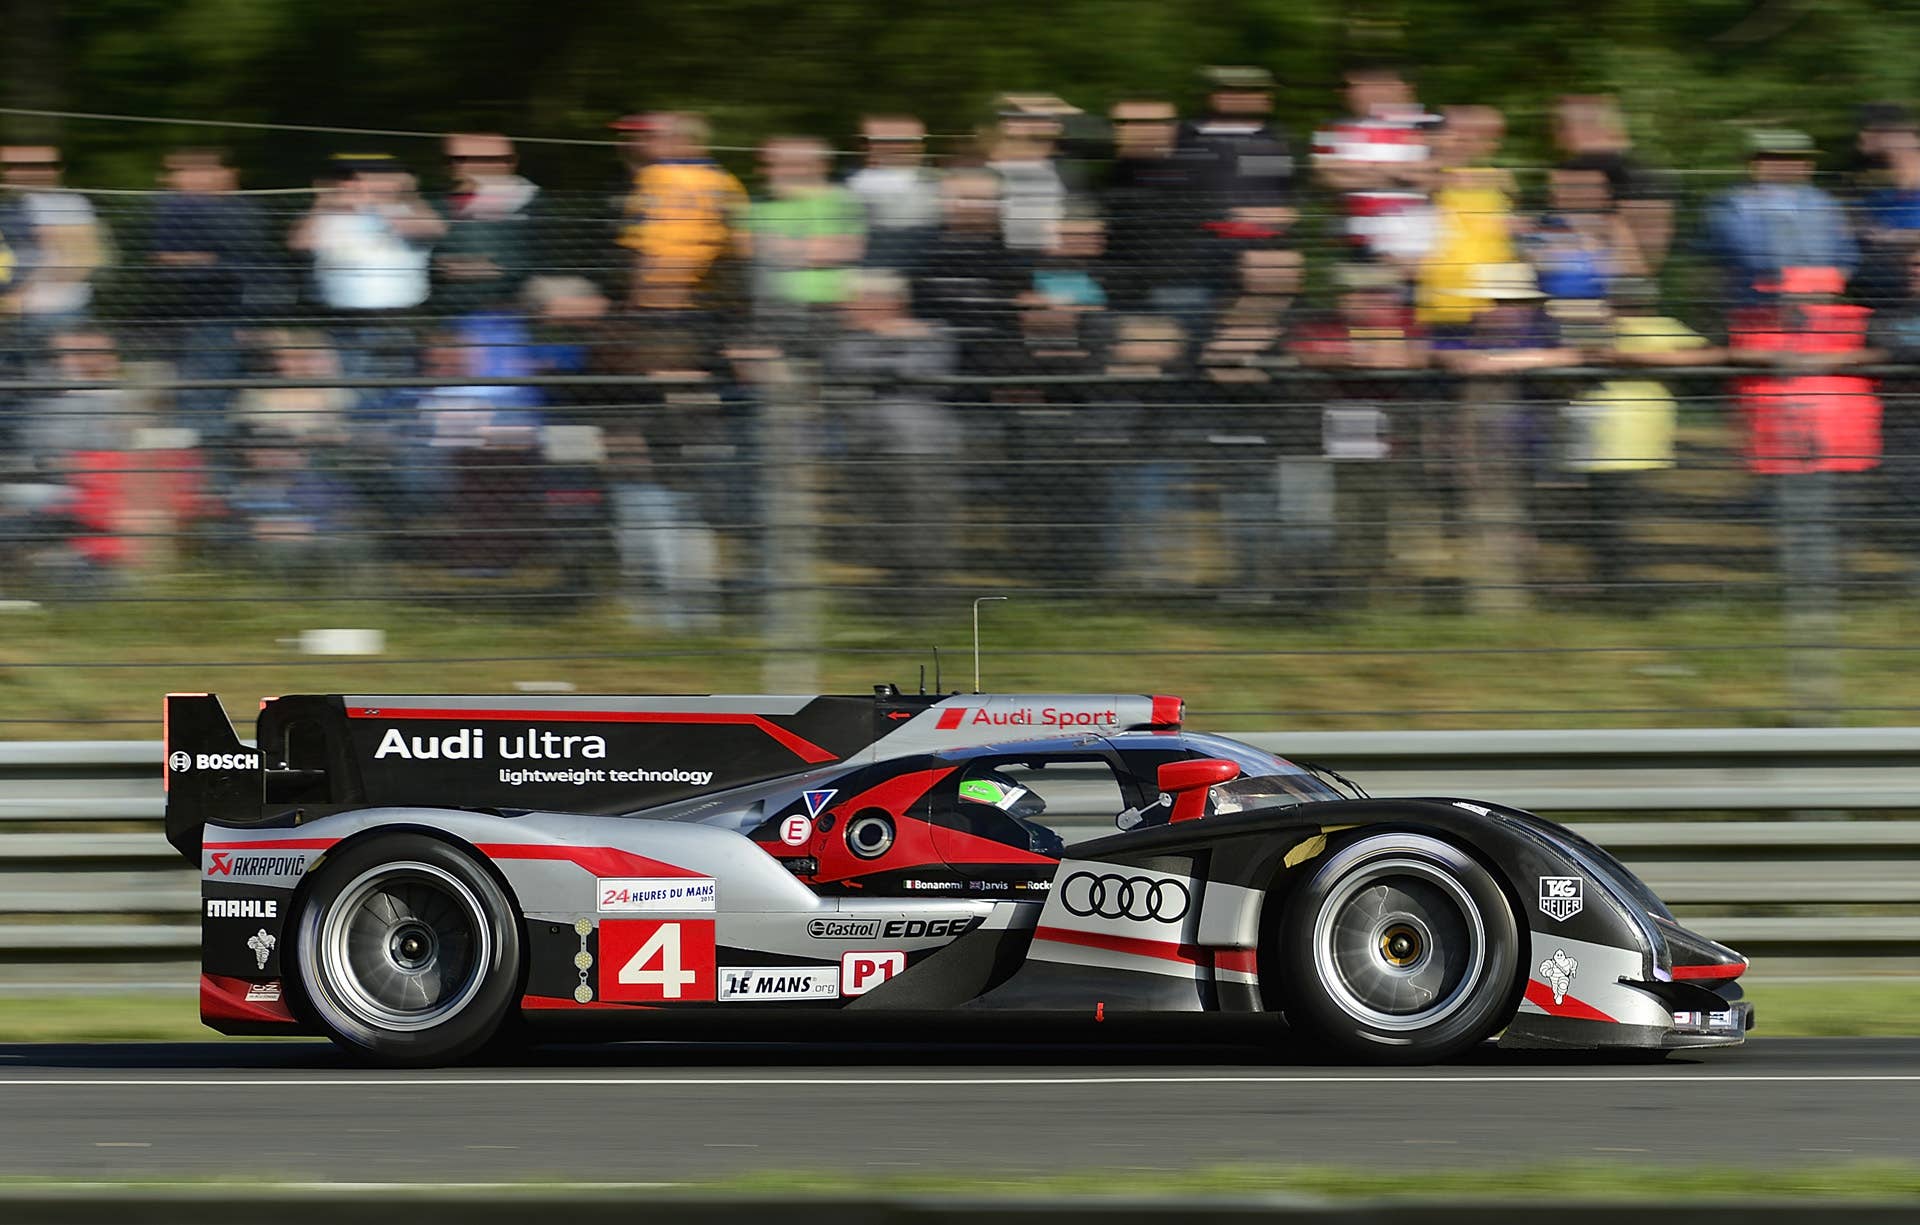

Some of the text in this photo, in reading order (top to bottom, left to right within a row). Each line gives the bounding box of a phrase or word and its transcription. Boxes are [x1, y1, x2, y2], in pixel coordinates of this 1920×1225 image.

[972, 708, 1117, 729] Audi Sport
[374, 728, 607, 759] Audi ultra
[196, 753, 260, 770] BOSCH
[499, 768, 713, 786] lightweight technology
[787, 820, 804, 841] E
[915, 880, 963, 890] Bonanomi
[981, 880, 1009, 890] Jarvis
[1546, 879, 1576, 897] TAG
[602, 885, 714, 905] 24 HEURES DU MANS
[207, 900, 277, 918] MAHLE
[1542, 900, 1580, 918] HEUER
[825, 919, 969, 938] Castrol EDGE
[618, 923, 696, 998] 4
[853, 959, 894, 988] P1
[729, 976, 750, 994] LE
